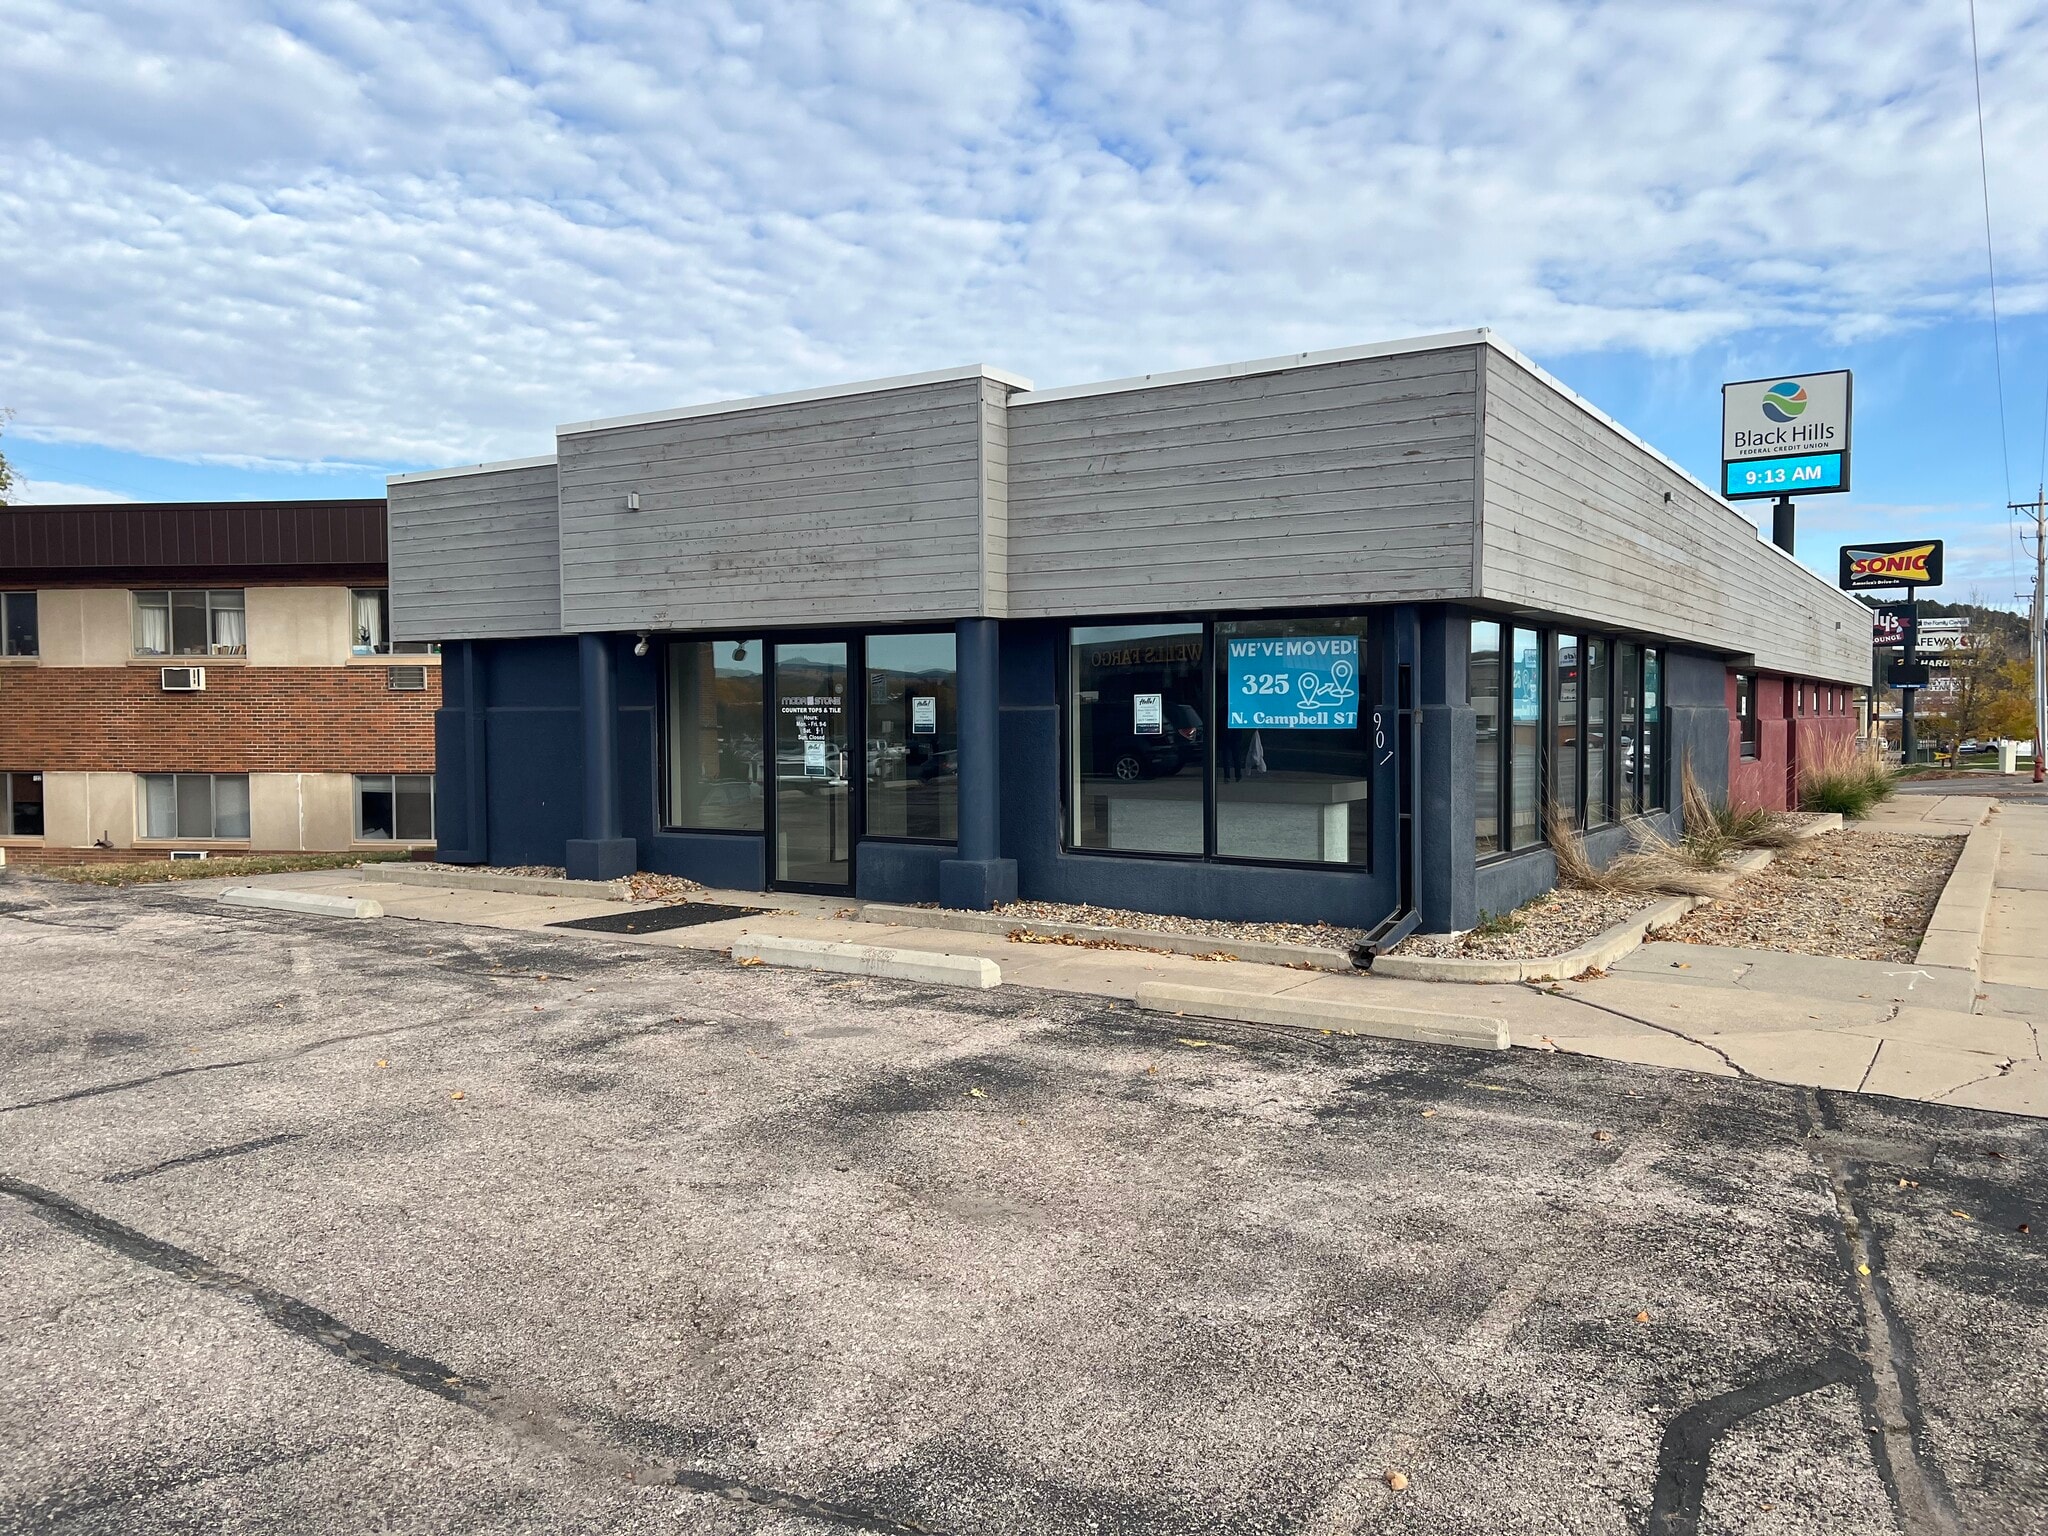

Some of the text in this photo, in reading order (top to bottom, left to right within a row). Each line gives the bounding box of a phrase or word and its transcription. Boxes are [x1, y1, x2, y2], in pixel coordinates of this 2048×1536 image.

[1734, 422, 1835, 448] Black Hills
[1739, 441, 1830, 456] FEDERAL CREDIT UNION
[1745, 465, 1822, 485] 9:13 AM
[1854, 554, 1929, 574] SONIC
[1873, 608, 1900, 632] ly's
[1872, 633, 1902, 644] OUNGE
[1917, 637, 1958, 646] FEWAY
[1230, 640, 1357, 657] WE'VE MOVED!
[1241, 674, 1290, 695] 325
[1231, 712, 1357, 728] N. Campbell ST
